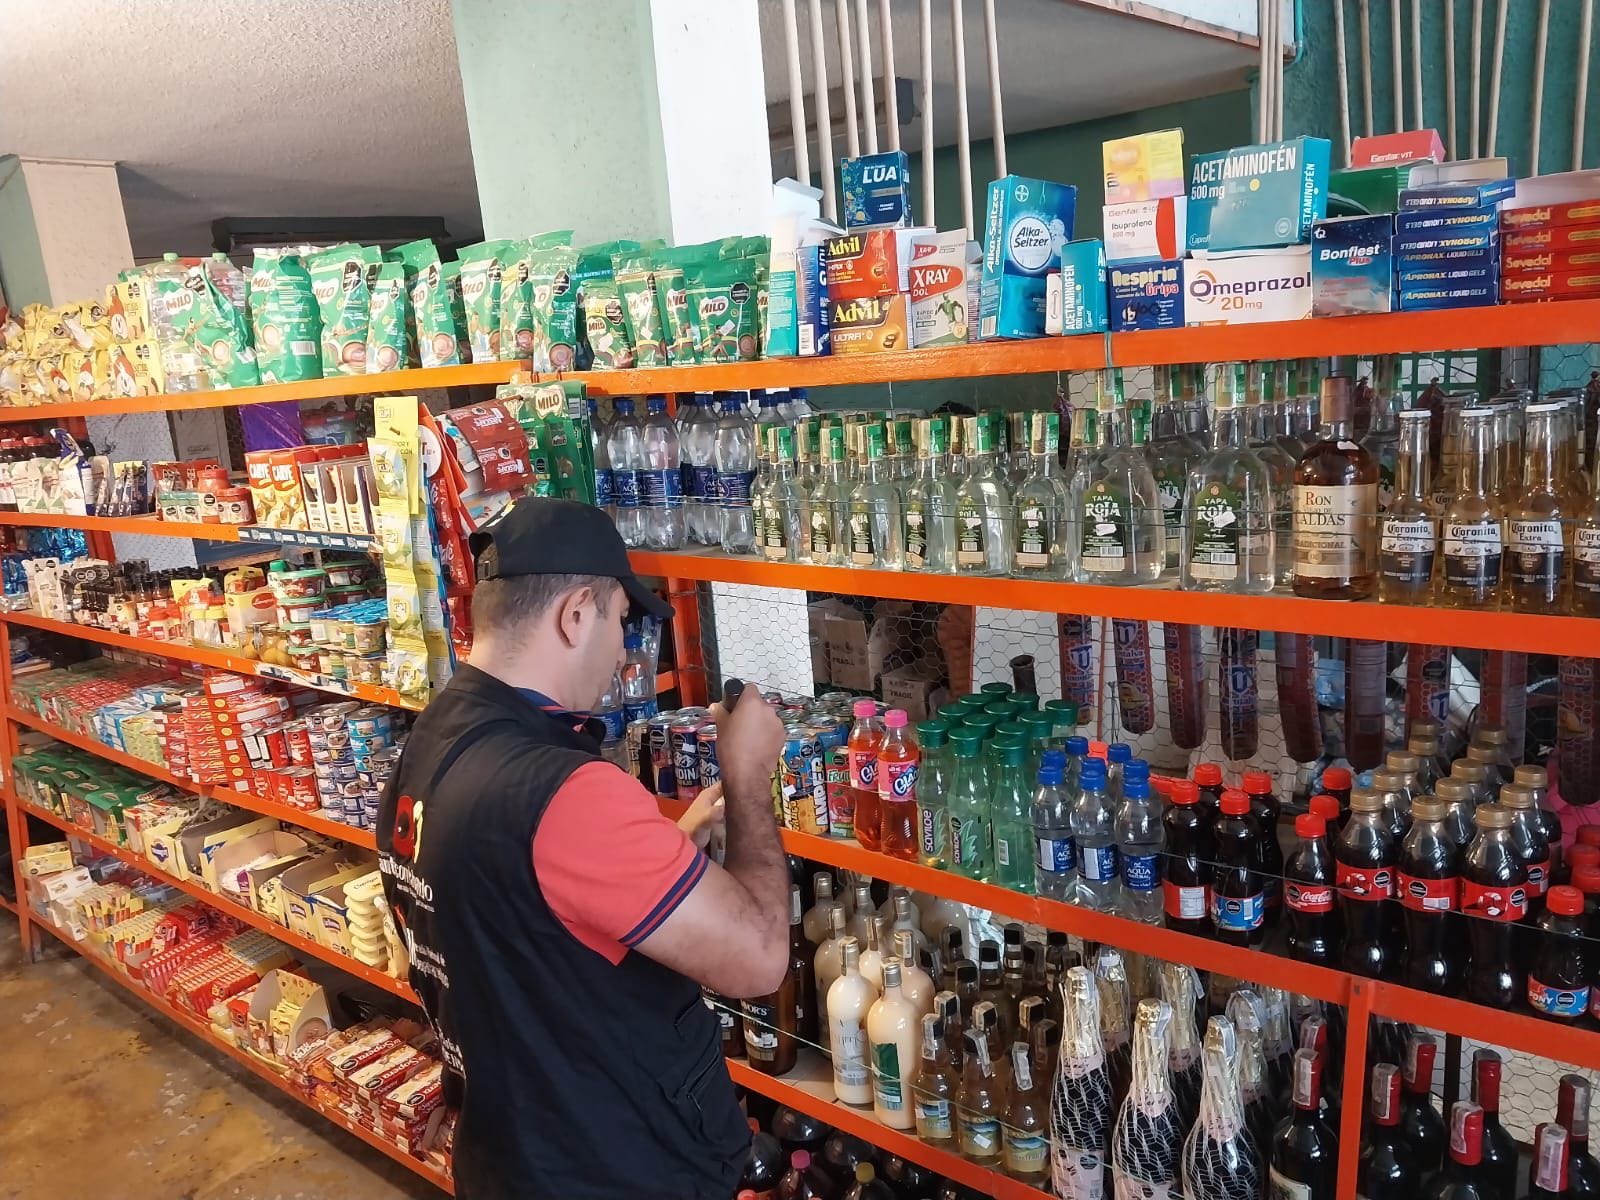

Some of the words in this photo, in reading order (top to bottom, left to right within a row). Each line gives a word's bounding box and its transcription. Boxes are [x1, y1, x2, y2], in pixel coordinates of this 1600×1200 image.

[1192, 144, 1296, 184] ACETAMINOFÉN
[863, 166, 897, 184] LUA
[1191, 185, 1208, 200] 500
[1208, 187, 1225, 201] mg
[1302, 163, 1316, 238] ACETAMINOFÉN
[1111, 219, 1153, 230] Ibuprofeno
[1422, 218, 1444, 228] LIQUID
[1444, 214, 1491, 225] APRONAX
[986, 186, 999, 274] Alka-Seltzer
[1016, 226, 1044, 238] Alka-
[828, 236, 861, 256] Advil
[1013, 236, 1049, 248] Seltzer
[1416, 240, 1438, 249] LIQUID
[1439, 236, 1485, 247] APRONAX
[1319, 243, 1380, 260] Bonfiest
[1348, 256, 1371, 266] Plus
[913, 267, 952, 289] XRAY
[1111, 265, 1178, 288] Respirin
[1405, 271, 1446, 282] APRONAX
[1447, 270, 1468, 279] LIQUID
[1146, 282, 1179, 297] Gripa
[1190, 271, 1311, 298] Omeprazol
[667, 289, 687, 307] MIL
[913, 288, 928, 297] DOL
[1405, 290, 1447, 301] APRONAX
[1448, 289, 1469, 298] LIQUID
[165, 292, 192, 311] MILO
[701, 301, 726, 316] MILO
[1221, 295, 1244, 311] 20
[1245, 299, 1263, 310] mg
[832, 300, 881, 323] Advil
[588, 321, 606, 332] MILO
[537, 393, 560, 410] MILO
[1305, 491, 1332, 506] RON
[1085, 502, 1122, 519] ROJA
[1387, 522, 1431, 535] Coronita
[1451, 525, 1498, 538] Coronita
[1511, 522, 1558, 535] Coronita
[1578, 530, 1600, 541] Coro
[1520, 534, 1542, 542] Extra
[1126, 867, 1151, 876] AQUA
[383, 1058, 420, 1080] Sopera
